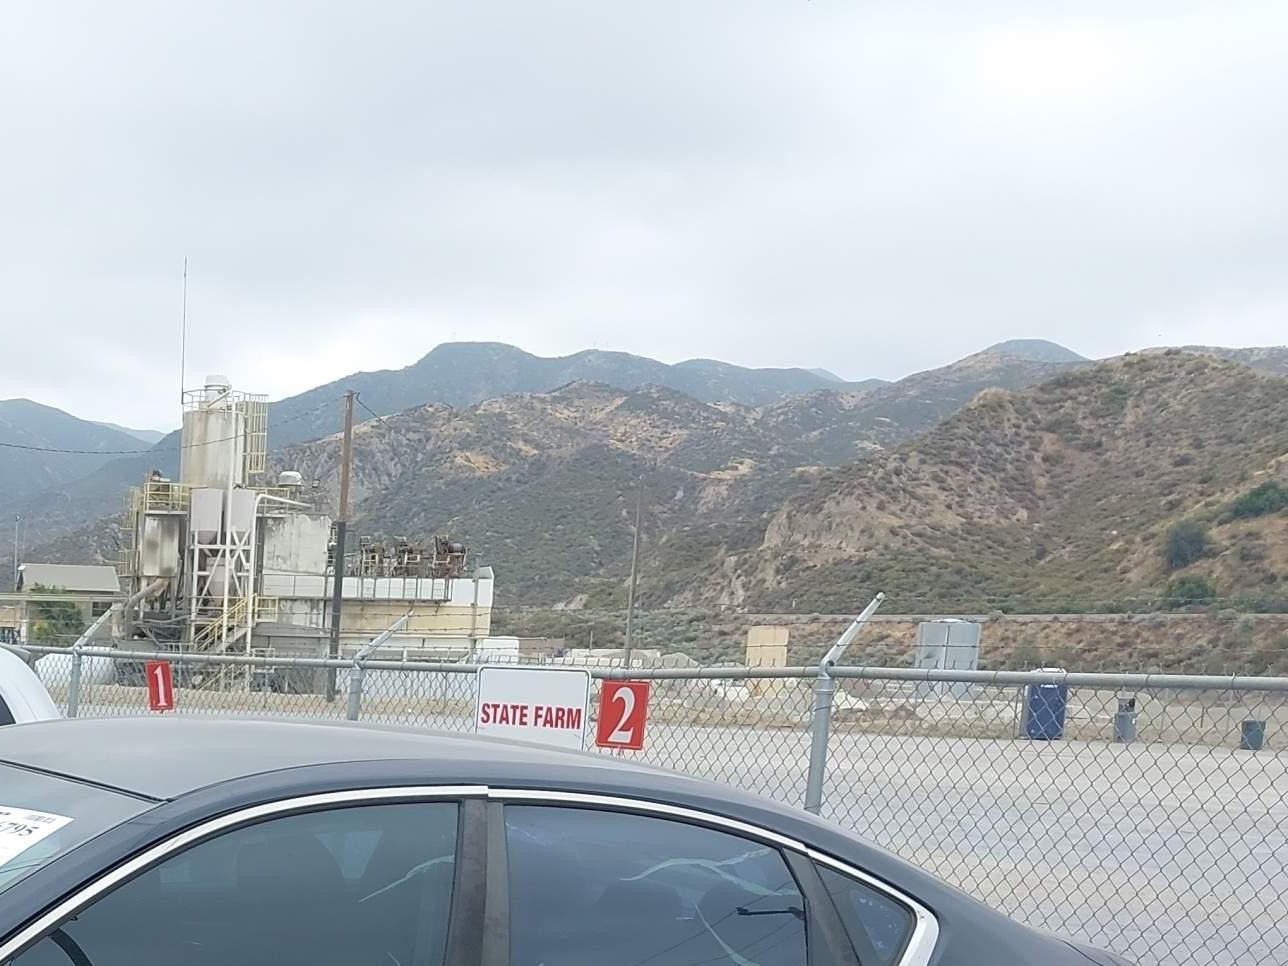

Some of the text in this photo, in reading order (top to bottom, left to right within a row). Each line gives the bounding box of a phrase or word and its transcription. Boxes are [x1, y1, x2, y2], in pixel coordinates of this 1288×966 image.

[154, 665, 168, 706] 1
[481, 703, 582, 730] STATE FARM
[607, 686, 636, 744] 2
